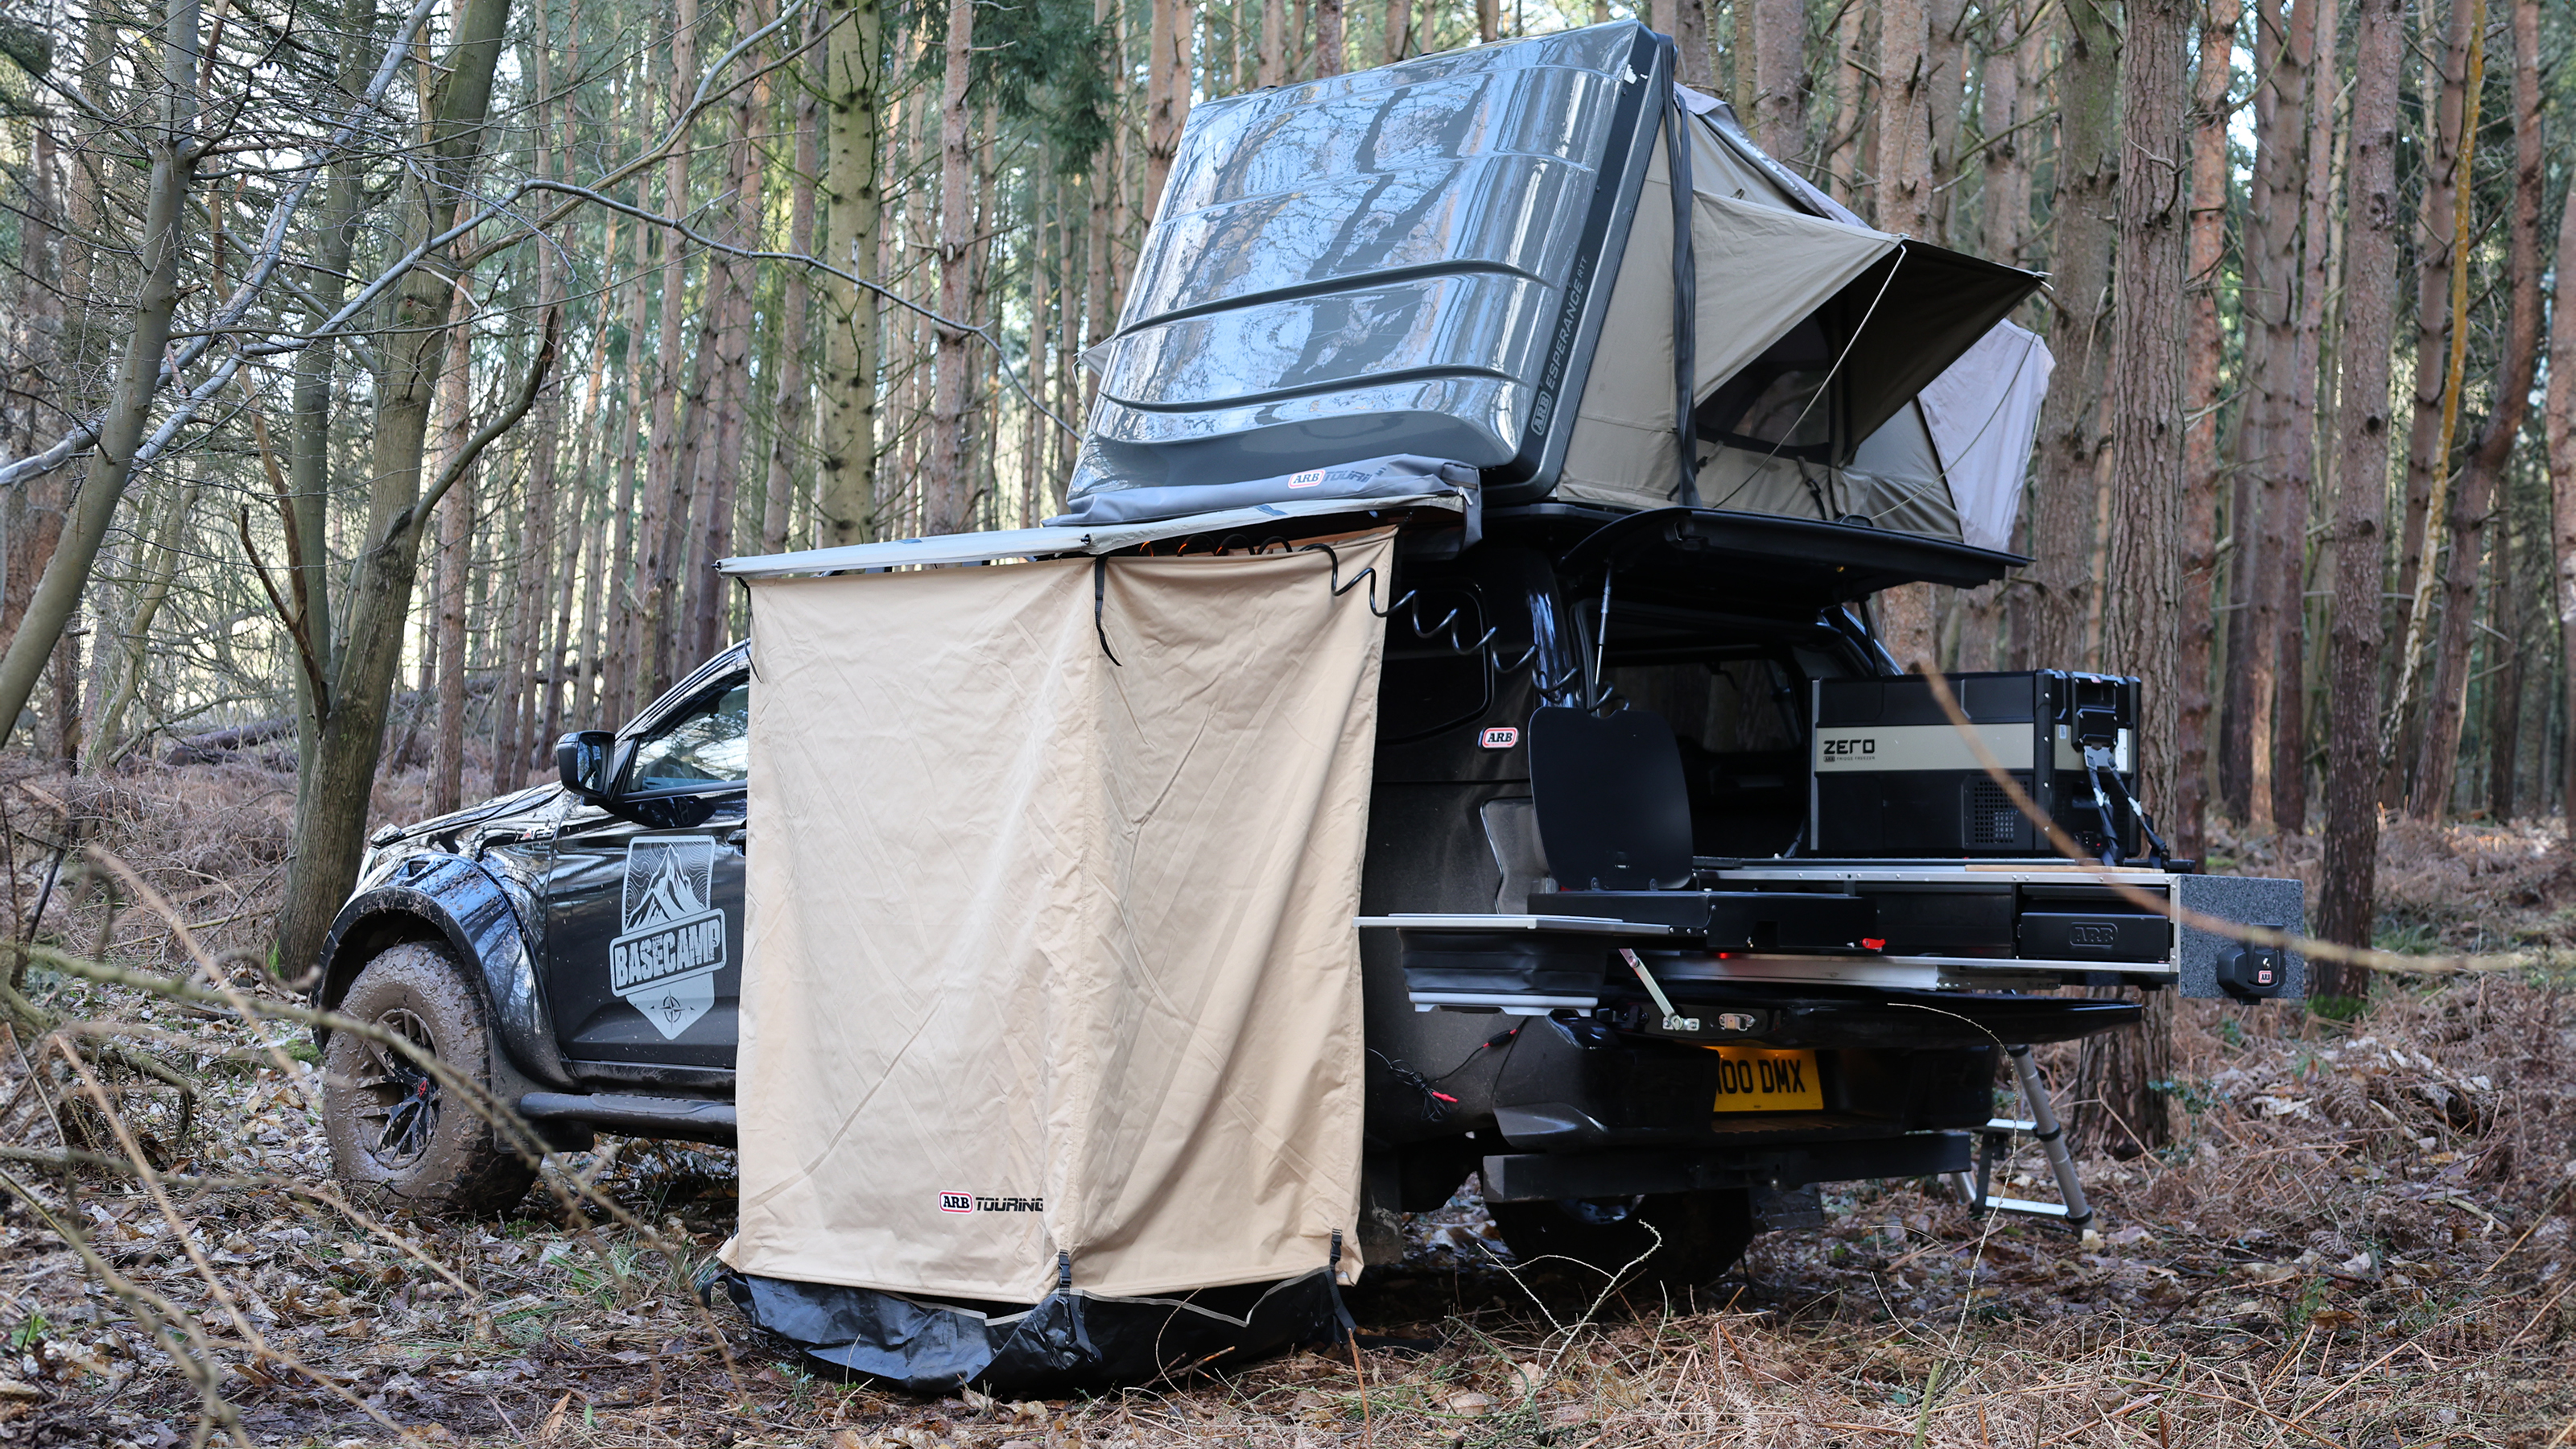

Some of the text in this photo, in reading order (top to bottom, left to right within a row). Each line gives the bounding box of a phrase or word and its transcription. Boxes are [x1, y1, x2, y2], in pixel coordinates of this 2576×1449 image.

[1533, 255, 1587, 432] ARB ESPERANCE RTT
[1292, 472, 1320, 485] ARB
[1487, 732, 1513, 743] ARB
[614, 919, 721, 988] BASECAMP
[1757, 1059, 1806, 1093] DMX
[943, 1195, 970, 1209] ARB
